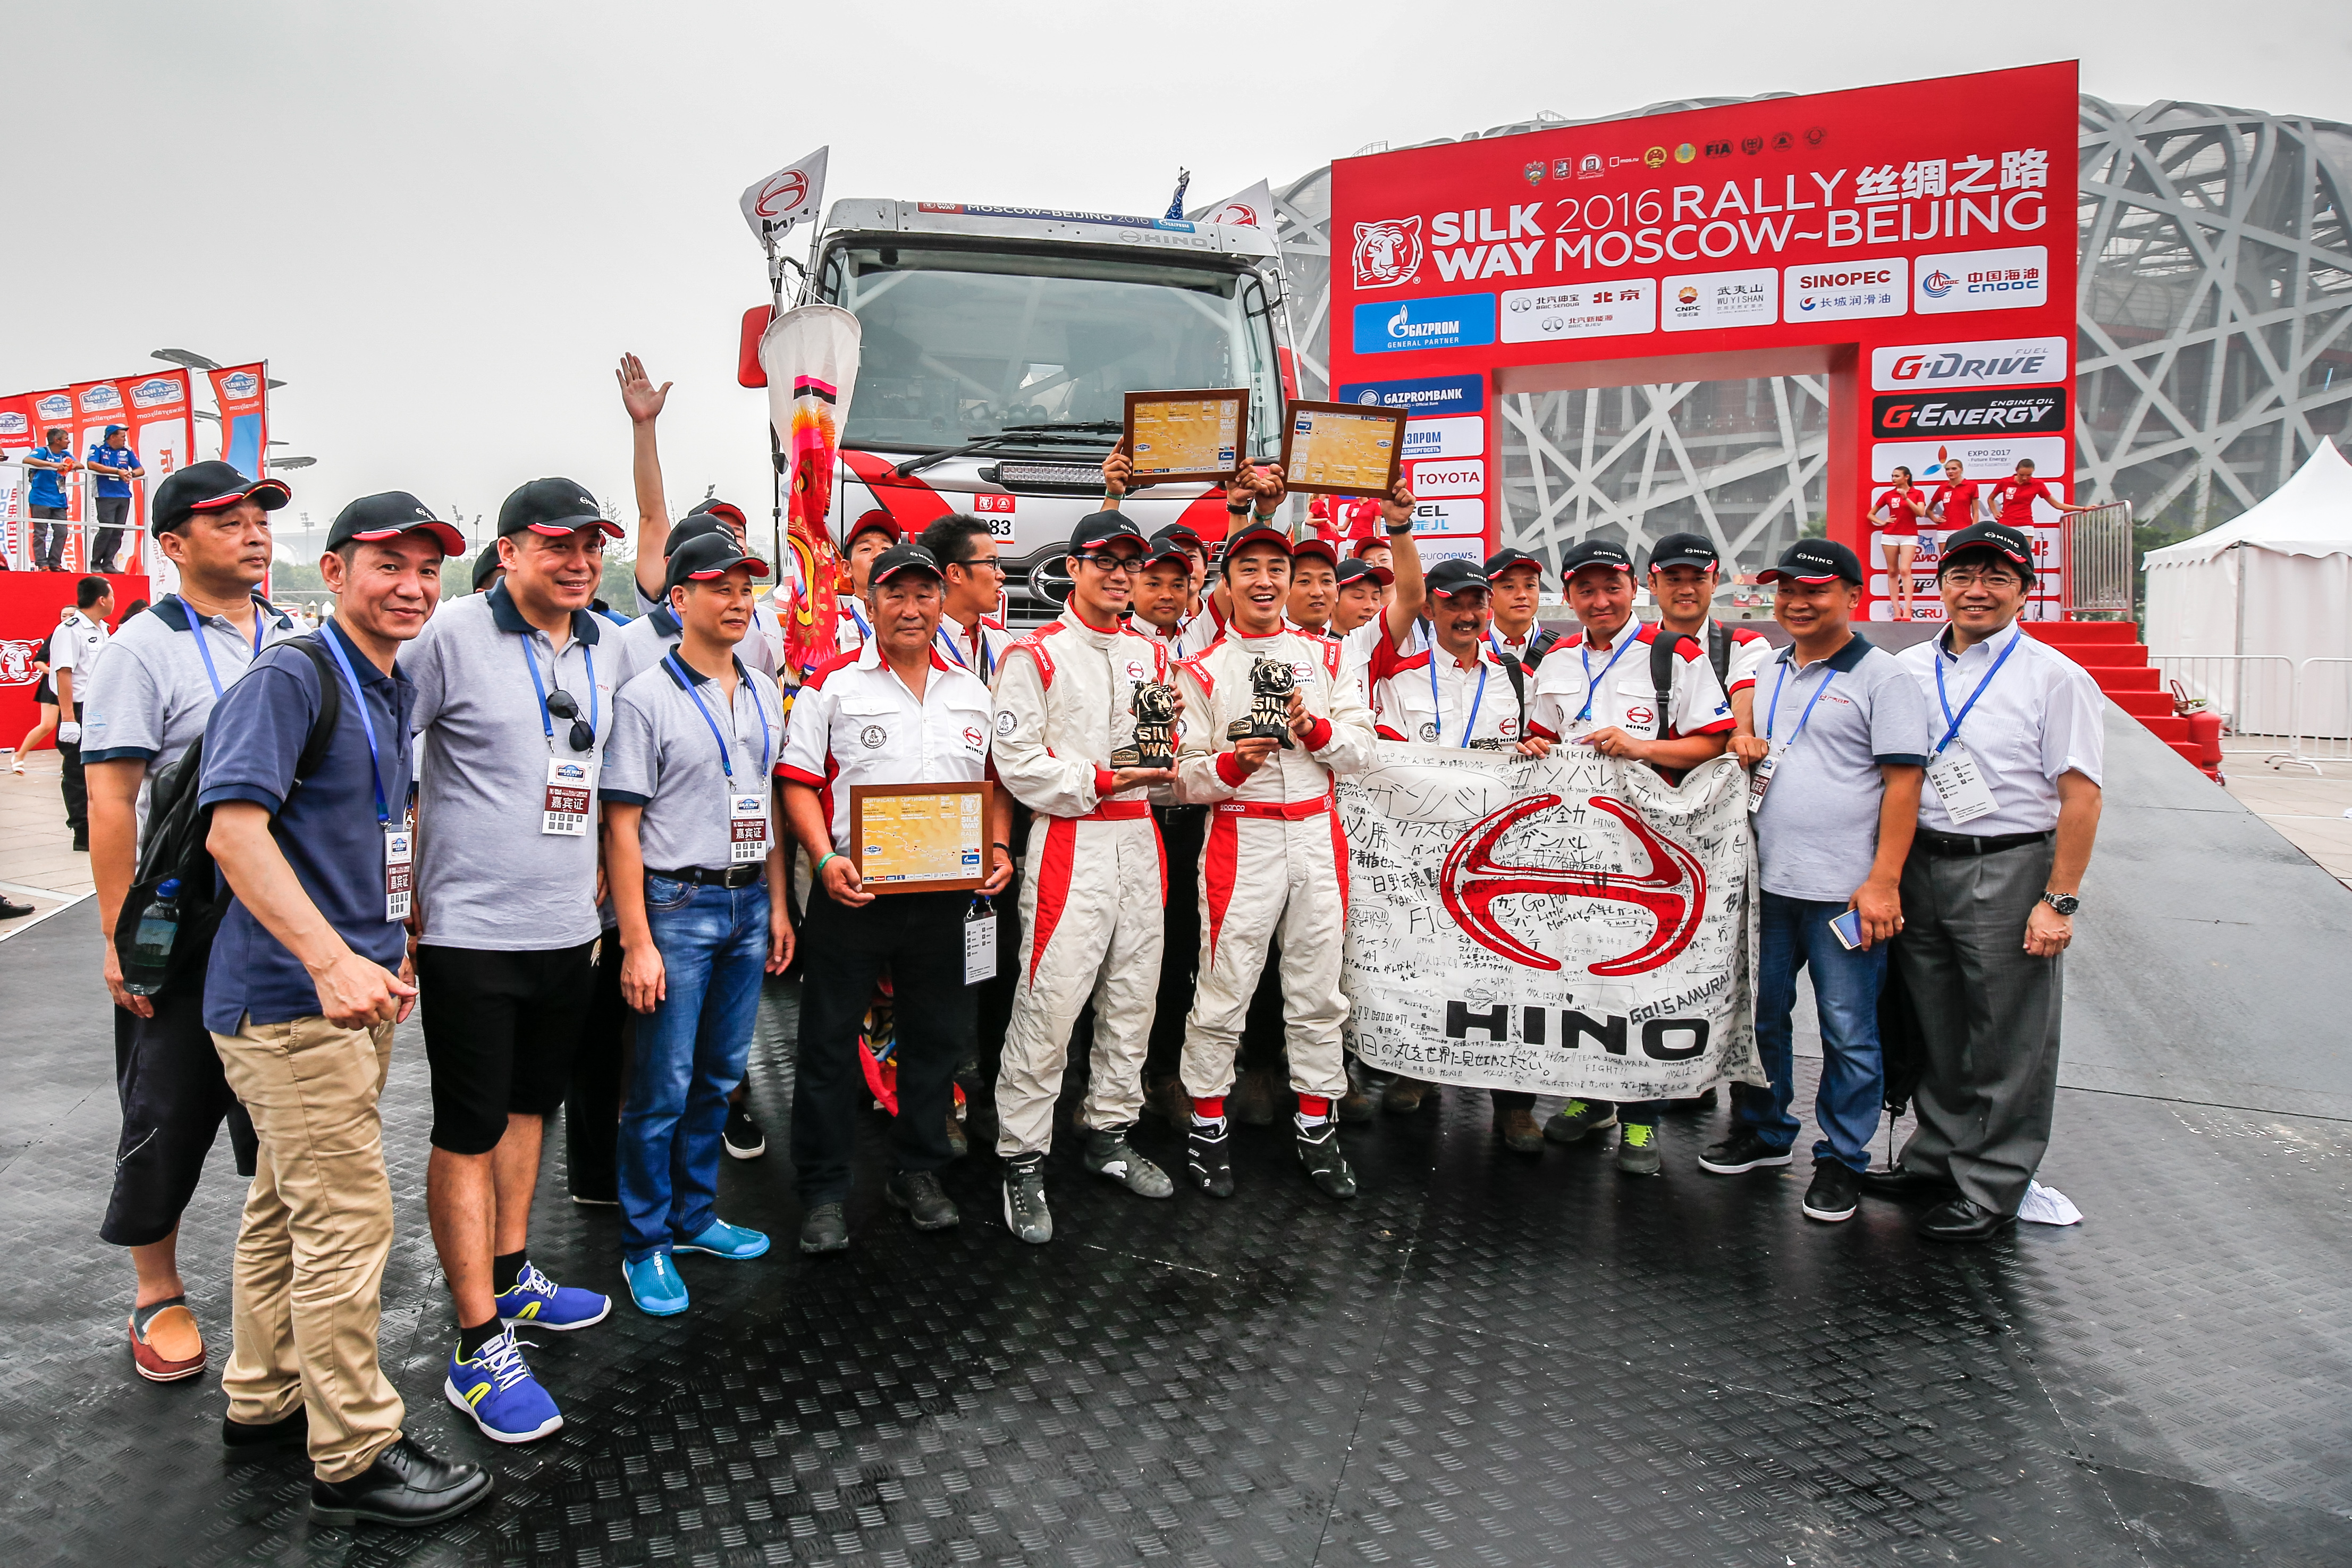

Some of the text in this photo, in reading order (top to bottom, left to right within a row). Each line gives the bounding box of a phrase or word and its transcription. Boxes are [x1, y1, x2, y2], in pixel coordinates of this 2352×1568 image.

[1431, 148, 2049, 246] SILK 2016 RALLY 丝绸之路
[1117, 216, 1149, 225] 2016
[1144, 234, 1208, 247] HINO
[1431, 239, 1545, 282] WAY
[1800, 269, 1891, 289] SINOPEC
[1968, 267, 2039, 284] 中国海油
[1592, 289, 1640, 304] 北京
[1717, 284, 1764, 296] 武夷山
[1536, 294, 1580, 305] 北汽绅宝
[1717, 294, 1764, 305] WU YI SHAN
[1820, 293, 1891, 309] 长城润滑油
[1568, 314, 1613, 324] 北汽新能源
[1409, 320, 1460, 336] GAZPROM
[1387, 336, 1460, 348] GENERAL PARTNER
[1384, 388, 1463, 404] GAZPROMBANK
[1417, 471, 1480, 485] TOYOTA
[1996, 534, 2020, 549] HINO
[1601, 551, 1623, 559] HINO
[1806, 554, 1833, 565] HINO
[1033, 645, 1050, 671] sparco
[1328, 645, 1337, 667] sparco
[1191, 663, 1209, 683] sparco
[965, 745, 983, 756] HINO
[1531, 785, 1551, 794] Just
[551, 796, 584, 810] 嘉宾证
[1219, 804, 1246, 812] sparco
[1593, 818, 1616, 828] HINO
[736, 827, 762, 839] 嘉宾证
[390, 874, 409, 889] 嘉宾证
[1522, 893, 1545, 912] Go
[1538, 907, 1564, 921] Little
[1446, 1000, 1710, 1061] HINO
[1604, 1055, 1650, 1068] SUGAWARA
[1585, 1064, 1628, 1076] FIGHT!!
